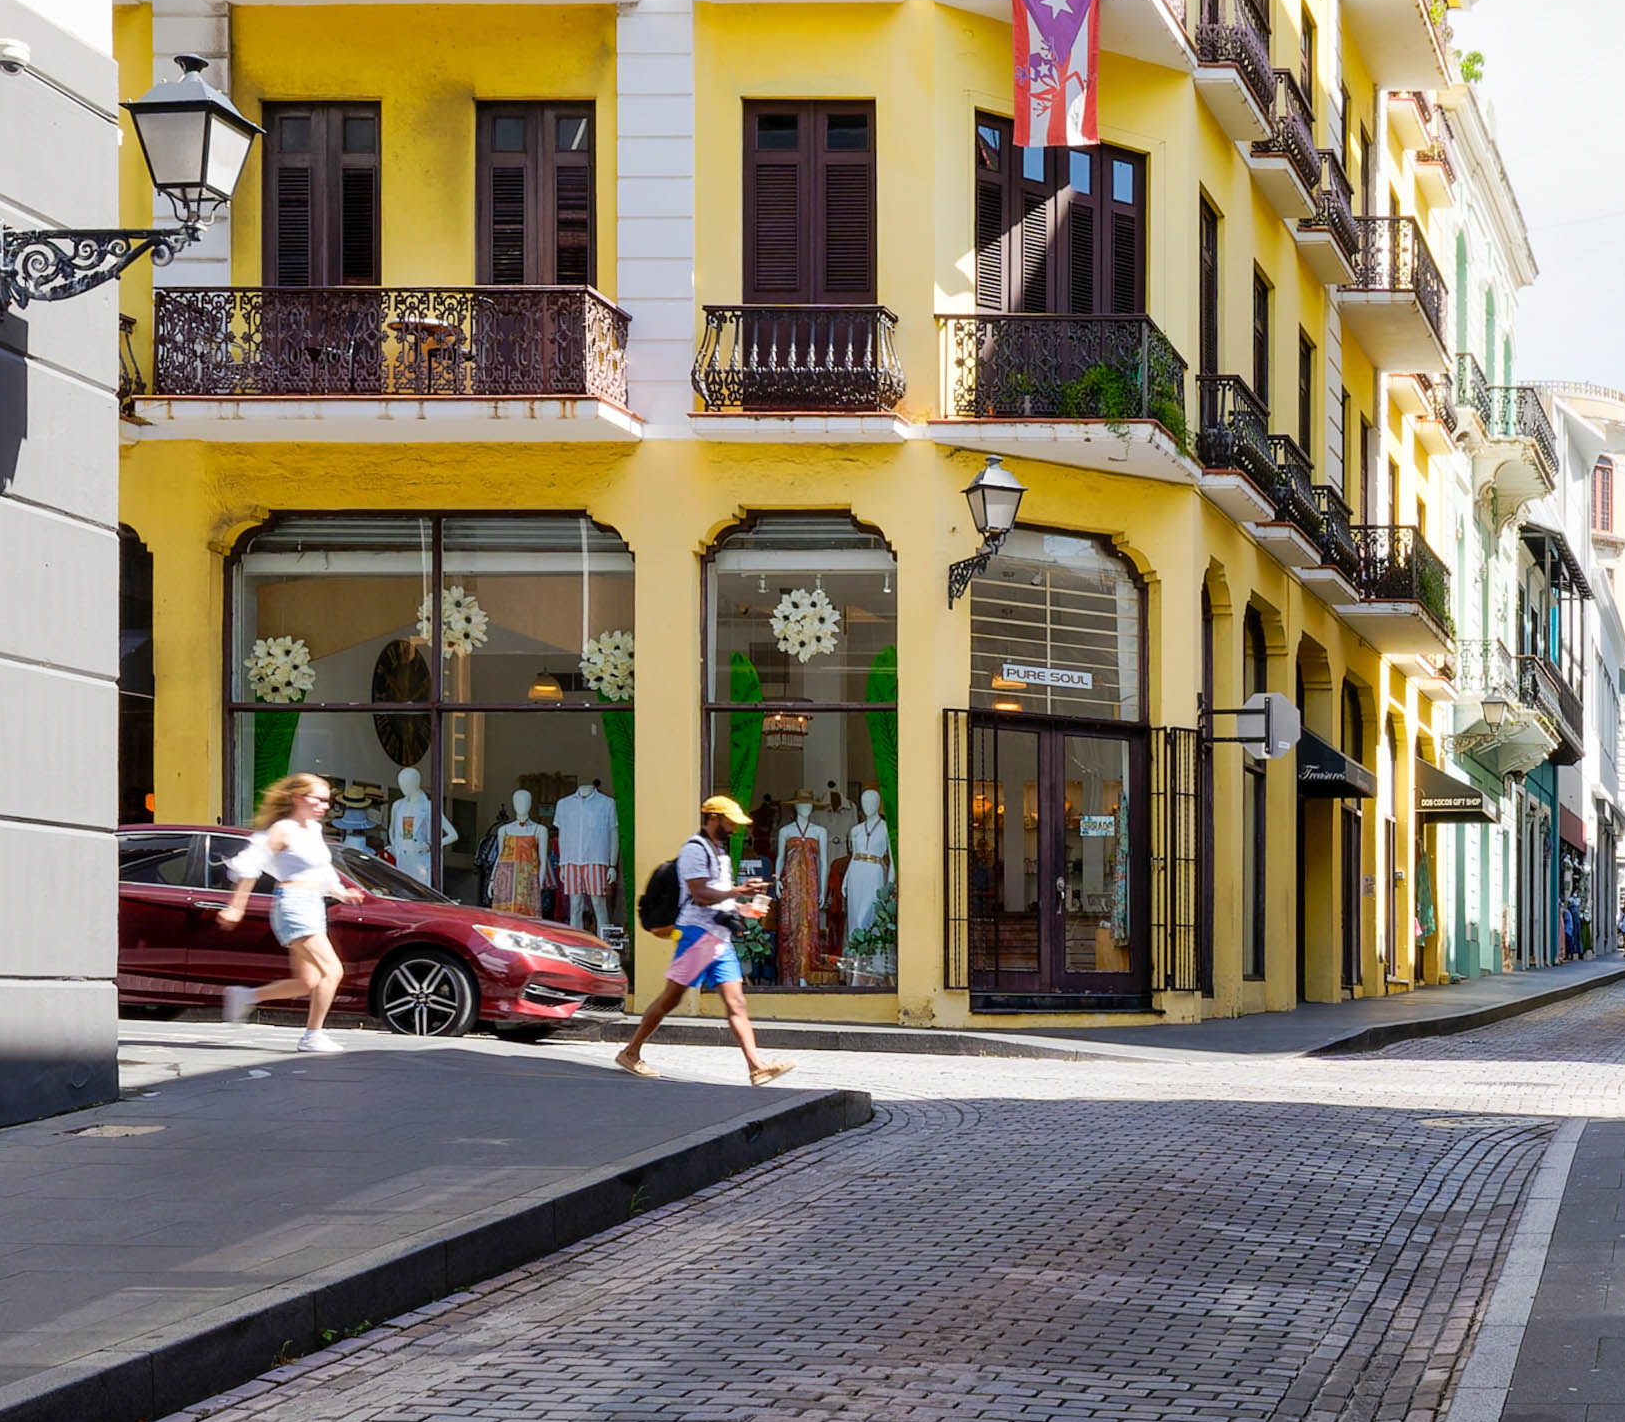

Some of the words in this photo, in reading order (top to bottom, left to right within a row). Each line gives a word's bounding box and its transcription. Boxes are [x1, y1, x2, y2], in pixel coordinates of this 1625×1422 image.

[1006, 668, 1046, 681] PURE
[1050, 672, 1089, 685] SOUL
[1299, 764, 1345, 781] Treasures
[1421, 799, 1433, 807] DOS
[1433, 798, 1452, 806] COCOS
[1453, 798, 1465, 806] GIFT
[1466, 797, 1482, 806] SHOP
